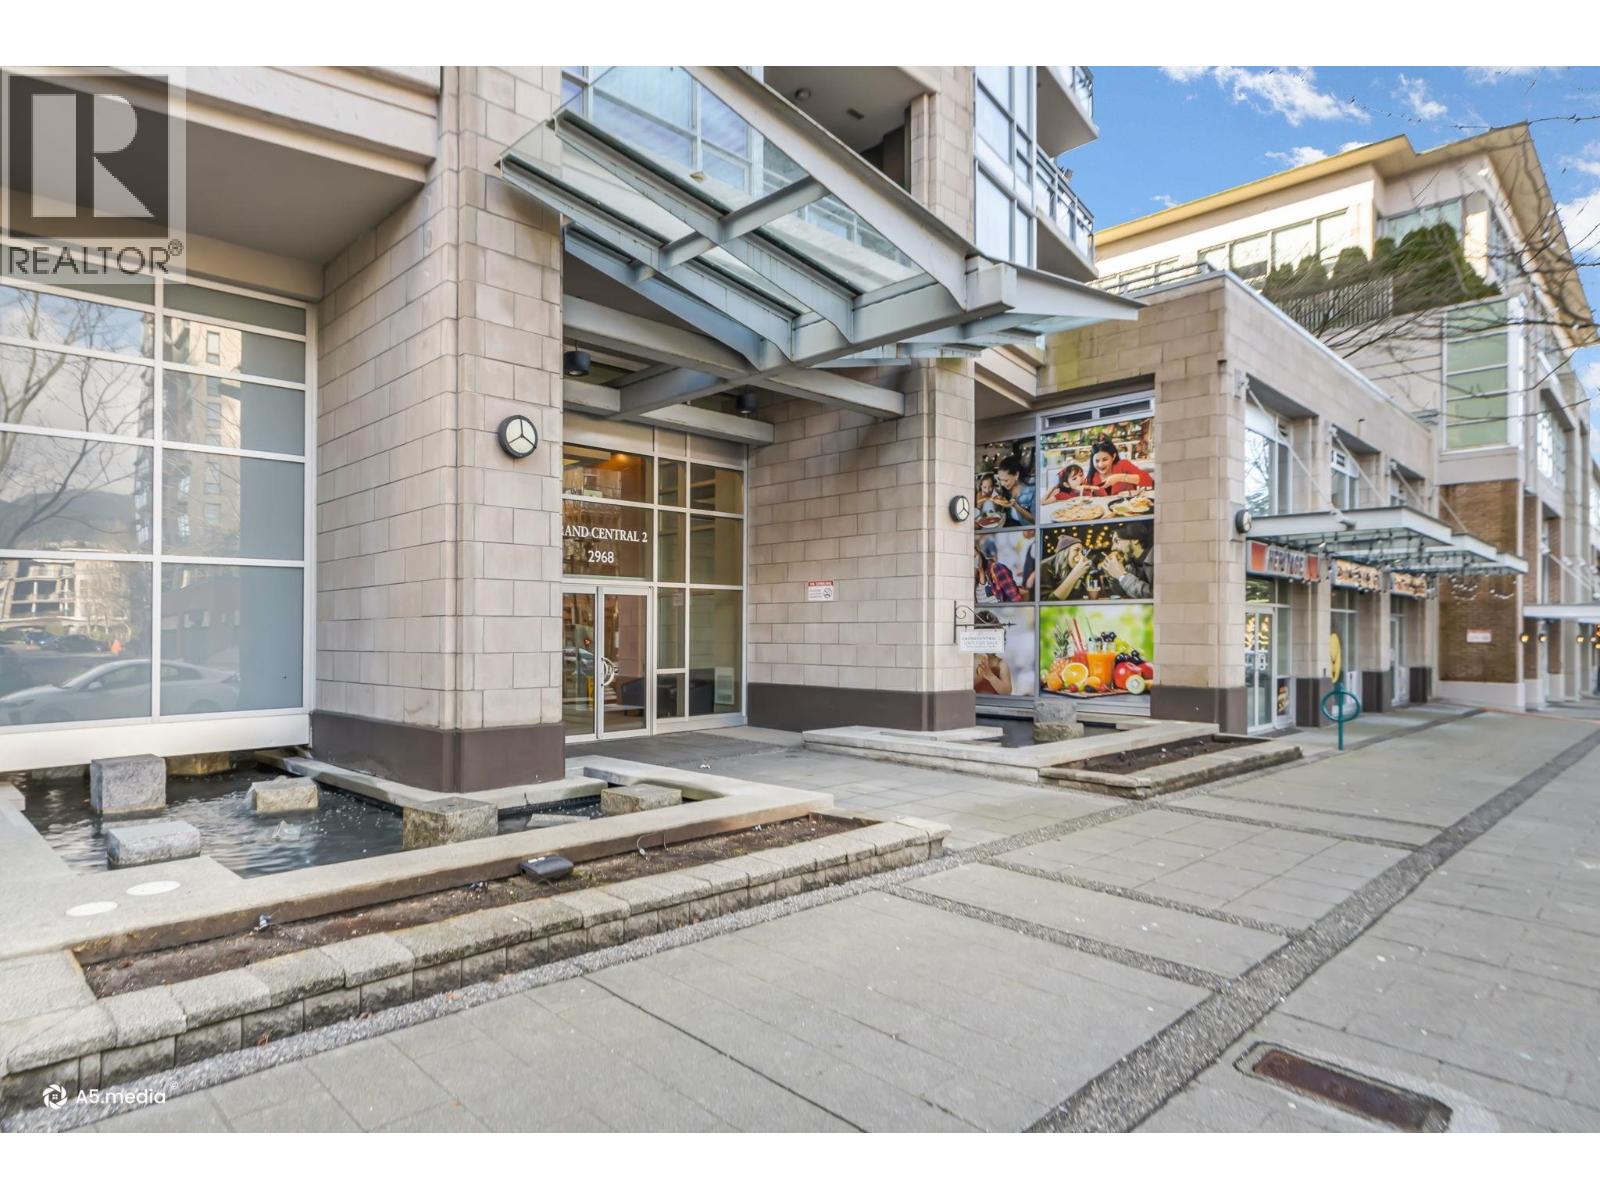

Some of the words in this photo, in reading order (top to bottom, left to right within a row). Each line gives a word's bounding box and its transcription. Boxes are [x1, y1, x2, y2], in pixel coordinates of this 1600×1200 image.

[591, 527, 640, 542] CENTRAL
[641, 531, 648, 543] 2
[588, 550, 615, 563] 2968
